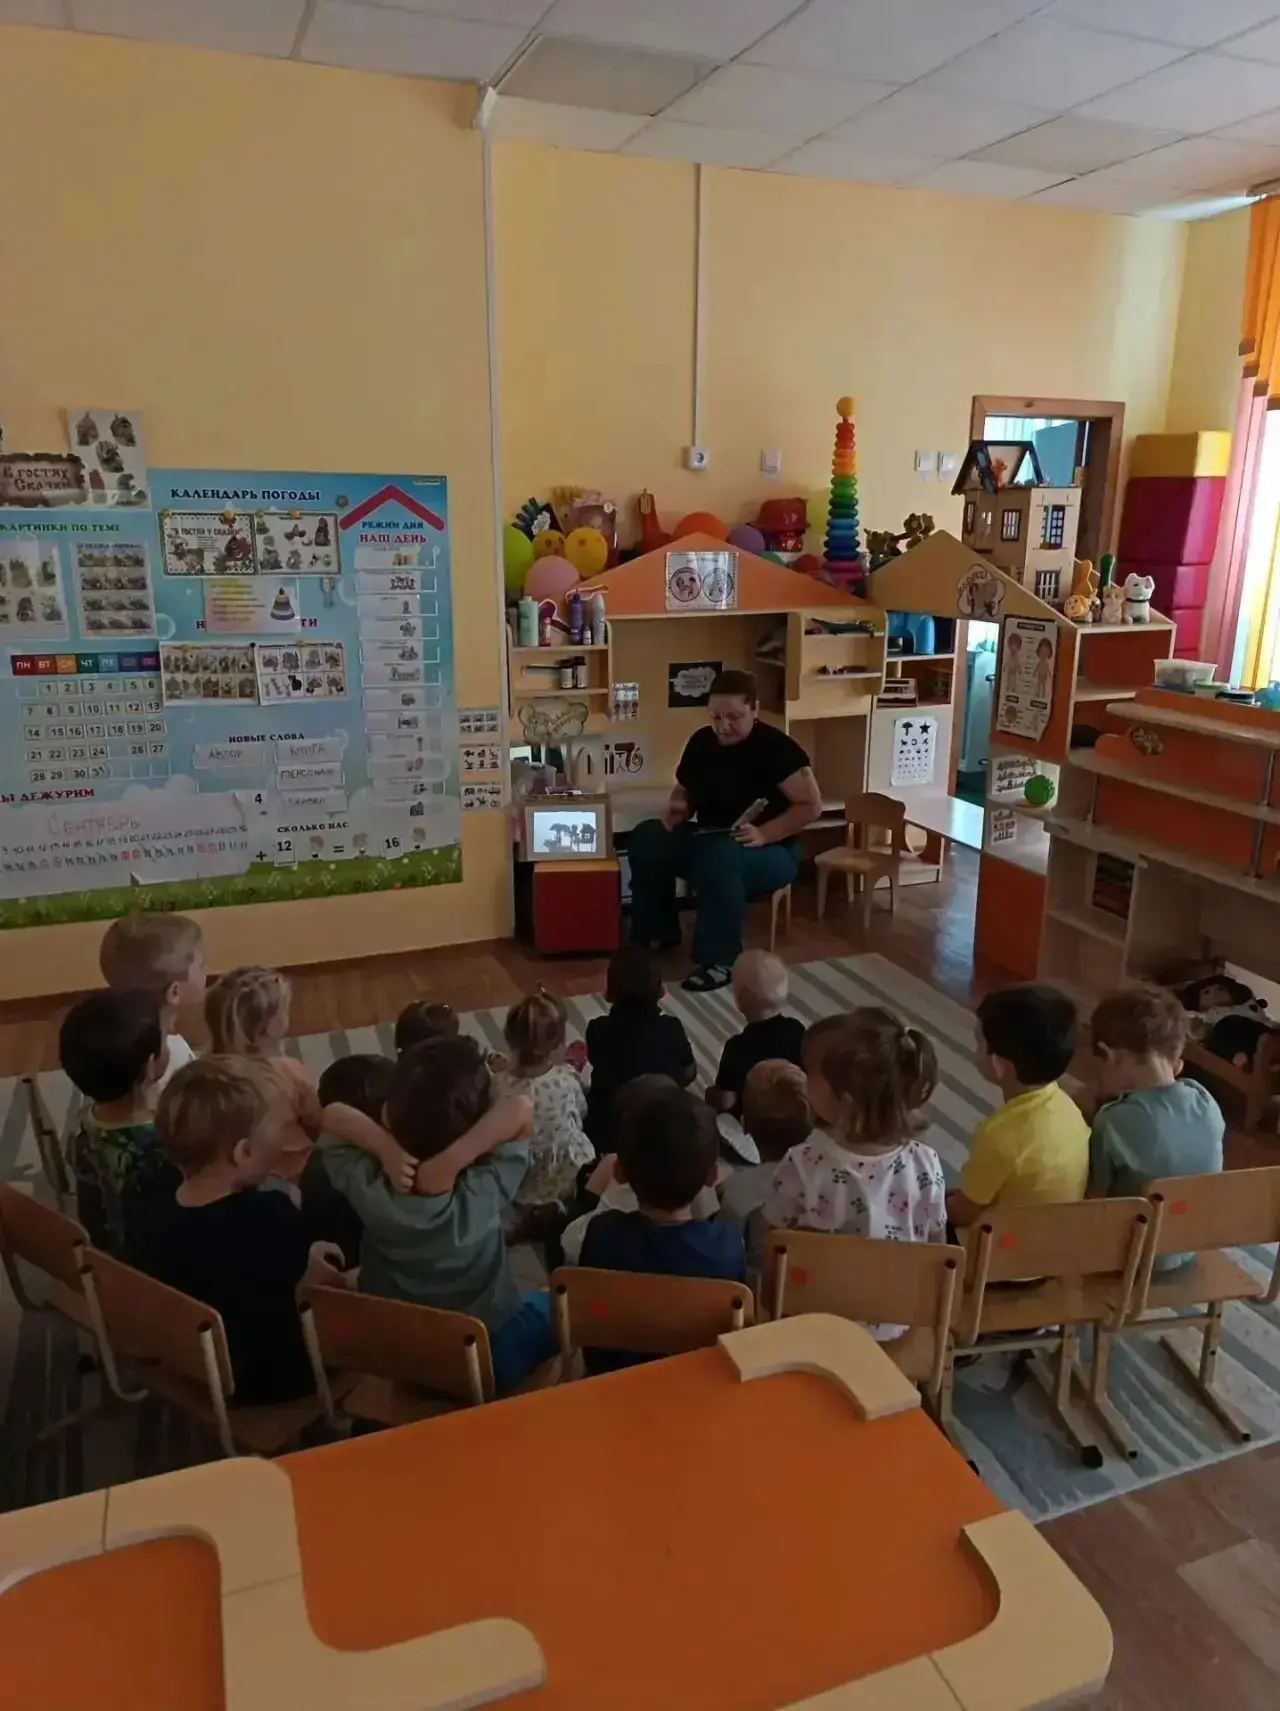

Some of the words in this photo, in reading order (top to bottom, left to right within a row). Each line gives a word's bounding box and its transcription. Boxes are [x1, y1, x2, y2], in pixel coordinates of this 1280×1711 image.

[170, 488, 258, 500] КАЛЕНДАРЬ
[261, 490, 320, 501] ПОГОДЫ
[72, 523, 88, 531] ПО
[362, 521, 400, 529] РЕЖИМ
[402, 521, 424, 530] ДНЯ
[360, 534, 390, 543] НАШ
[394, 534, 427, 543] ДЕНЬ
[80, 659, 93, 667] ЧТ
[87, 705, 99, 713] 10
[109, 704, 120, 712] 11
[128, 703, 141, 711] 12
[148, 702, 160, 711] 13
[27, 729, 40, 737] 14
[51, 728, 64, 736] 15
[69, 727, 82, 735] 16
[90, 726, 101, 734] 17
[112, 725, 124, 734] 18
[131, 724, 143, 733] 19
[149, 722, 161, 731] 20
[228, 734, 267, 744] НОВЫЕ
[269, 732, 305, 742] СЛОВА
[30, 752, 42, 760] 21
[49, 750, 62, 758] 22
[72, 749, 85, 758] 23
[92, 748, 105, 757] 24
[151, 744, 164, 753] 27
[32, 773, 46, 782] 28
[50, 770, 63, 779] 29
[20, 788, 95, 802] ДЕЖУРИМ
[254, 793, 263, 805] 4
[277, 824, 326, 834] СКОЛЬКО
[328, 821, 349, 831] НАС
[277, 841, 292, 852] 12
[384, 837, 400, 849] 16
